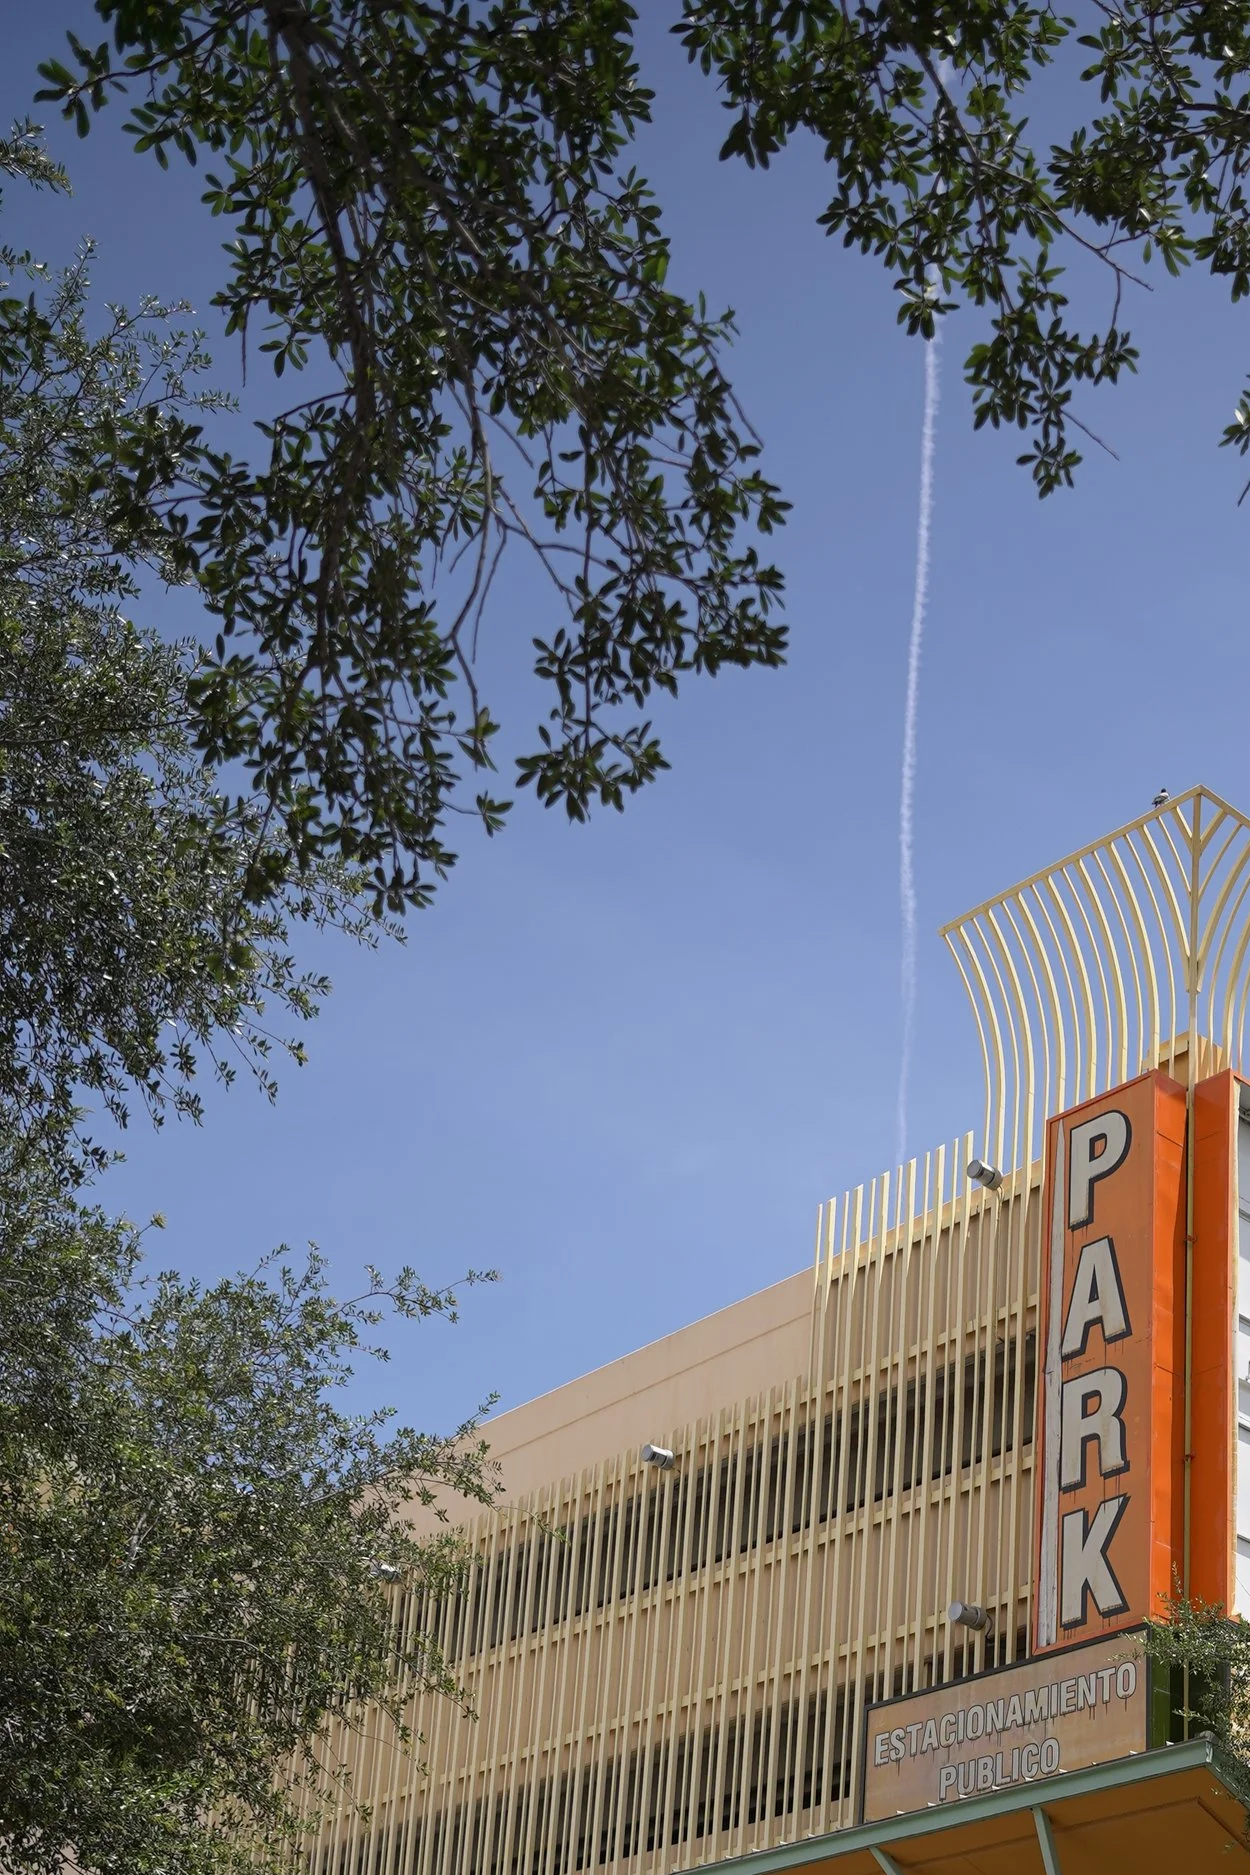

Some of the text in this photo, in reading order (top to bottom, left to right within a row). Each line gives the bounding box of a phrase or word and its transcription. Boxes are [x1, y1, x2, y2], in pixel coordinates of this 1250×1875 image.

[1060, 1109, 1132, 1629] PARK
[874, 1662, 1137, 1767] ESTACIONAMIENTO
[939, 1737, 1060, 1801] PUBLICO
